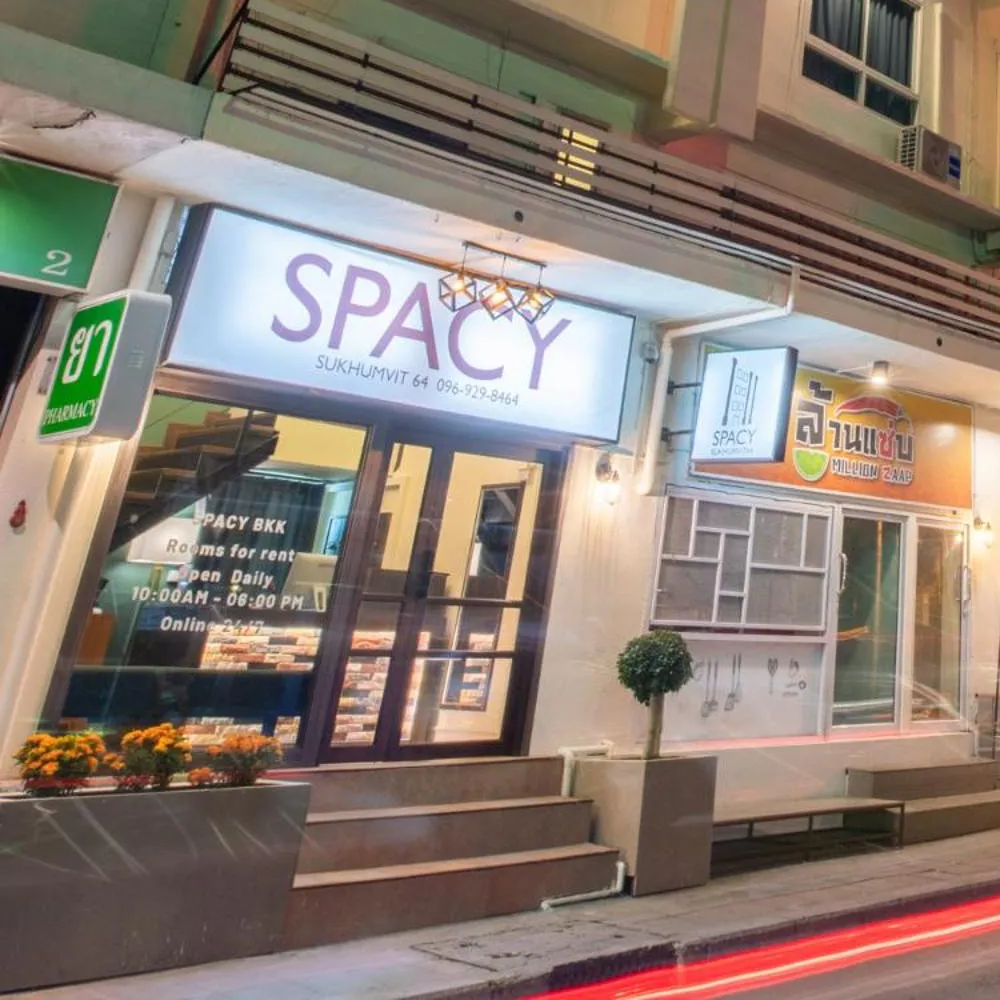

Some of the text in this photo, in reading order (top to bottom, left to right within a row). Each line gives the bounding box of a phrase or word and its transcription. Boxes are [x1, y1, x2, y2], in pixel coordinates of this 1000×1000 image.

[41, 249, 72, 276] 2
[271, 252, 572, 391] SPACY
[62, 320, 113, 385] ยา
[315, 354, 519, 406] SUKHUMVIT 64 096-929-8464
[43, 399, 97, 425] PHARMACY
[712, 428, 757, 447] SPACY
[831, 457, 913, 484] MILLION ZAAP
[252, 518, 287, 534] BKK
[166, 538, 295, 563] Rooms for rent
[231, 569, 274, 588] Daily
[132, 586, 209, 605] 10:00AM
[227, 592, 277, 609] 06:00
[280, 595, 304, 611] PM
[160, 615, 217, 633] Online
